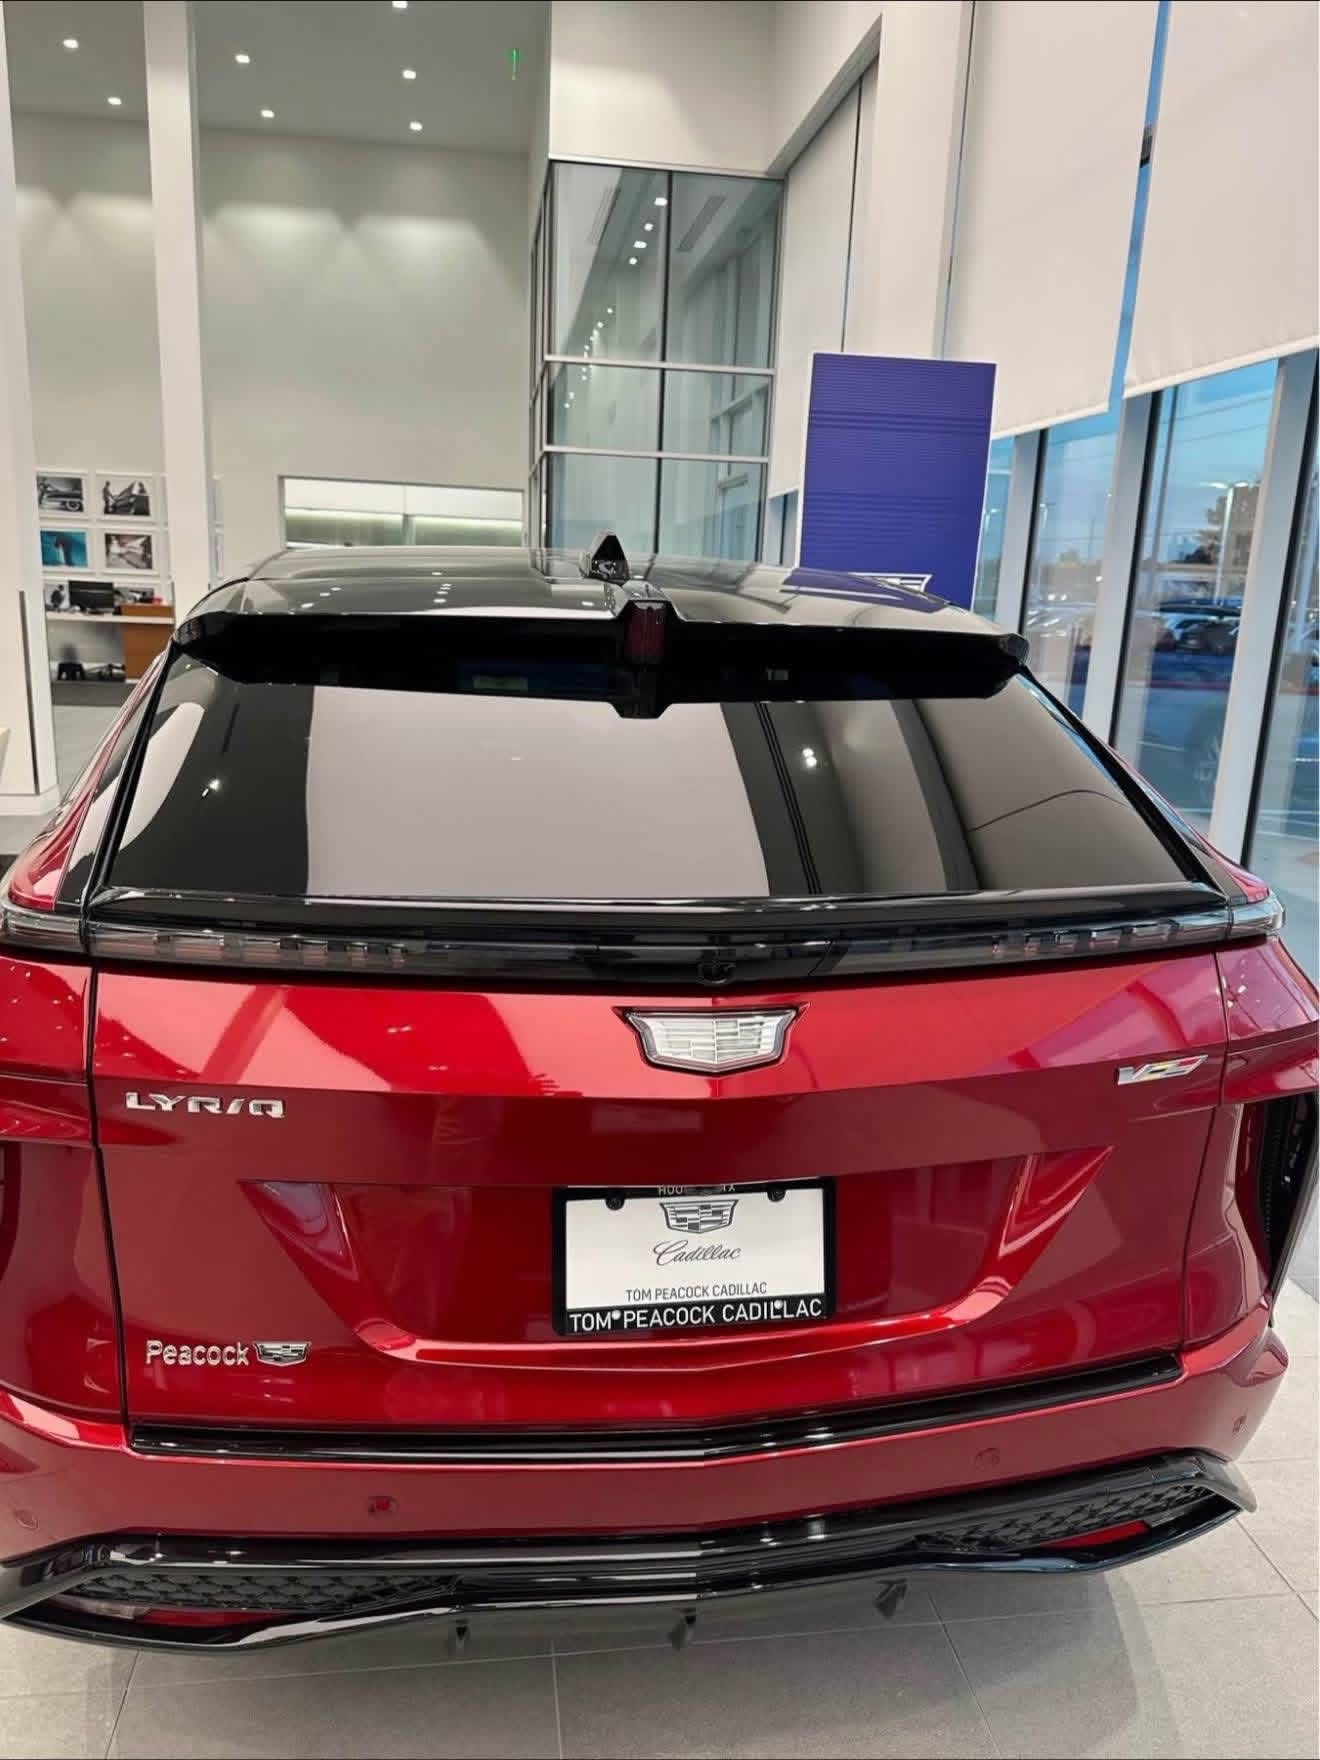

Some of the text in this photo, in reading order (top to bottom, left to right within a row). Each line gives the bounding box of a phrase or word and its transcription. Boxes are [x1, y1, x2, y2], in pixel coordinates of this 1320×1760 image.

[126, 1091, 285, 1118] LYRIQ
[653, 1239, 742, 1266] Cadillac
[625, 1281, 767, 1302] TOM PEACOCK CADILLAC
[569, 1299, 823, 1333] TOM PEACOCK CADILLAC
[146, 1339, 249, 1366] Peacock
